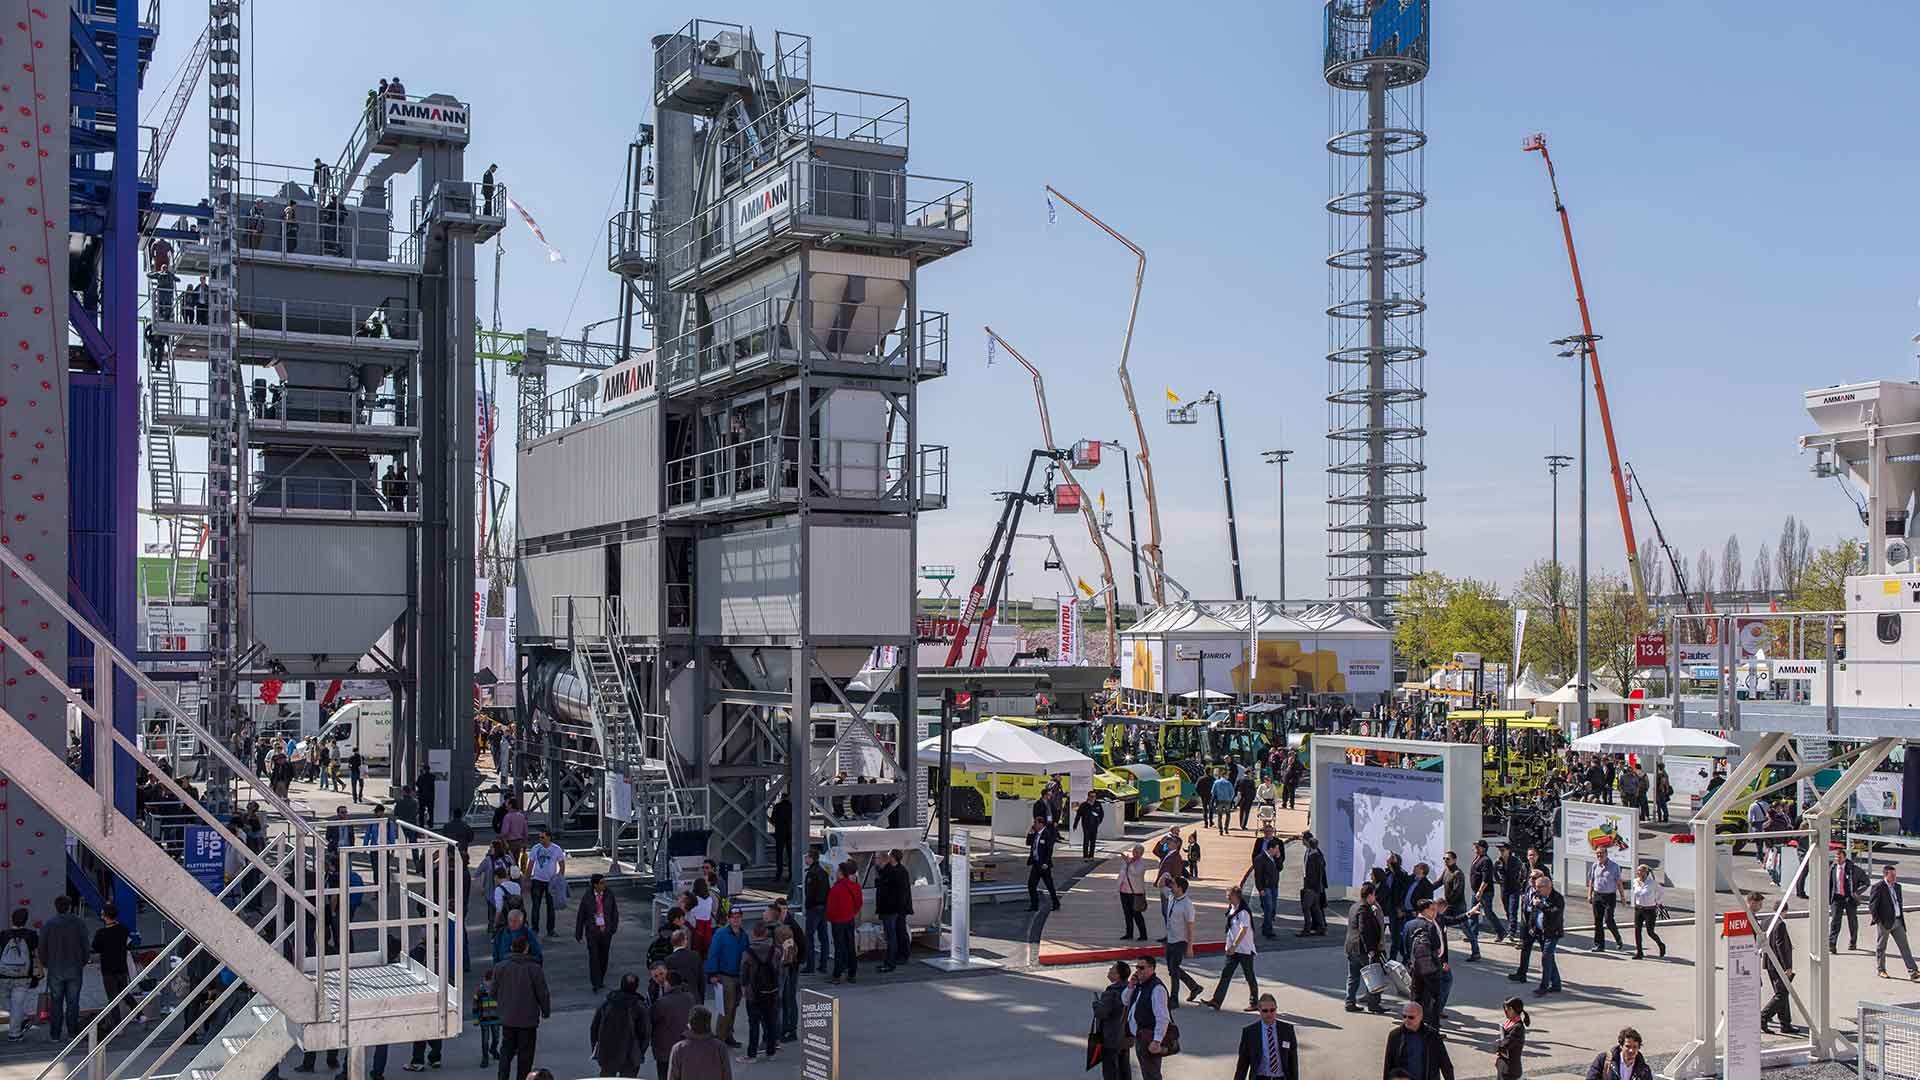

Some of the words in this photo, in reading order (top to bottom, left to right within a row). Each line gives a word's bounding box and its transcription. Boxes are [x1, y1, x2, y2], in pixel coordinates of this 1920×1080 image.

[388, 103, 467, 124] AMMANN
[740, 180, 788, 227] AMMANN
[603, 359, 654, 403] AMMANN
[1823, 393, 1856, 404] AMMANN
[508, 612, 517, 644] GEHL
[1060, 605, 1072, 653] MANITOU
[1640, 644, 1666, 656] 13.4
[1687, 651, 1712, 660] autec
[1778, 666, 1817, 675] AMMANN
[209, 831, 221, 859] TOP
[1729, 919, 1748, 930] NEW
